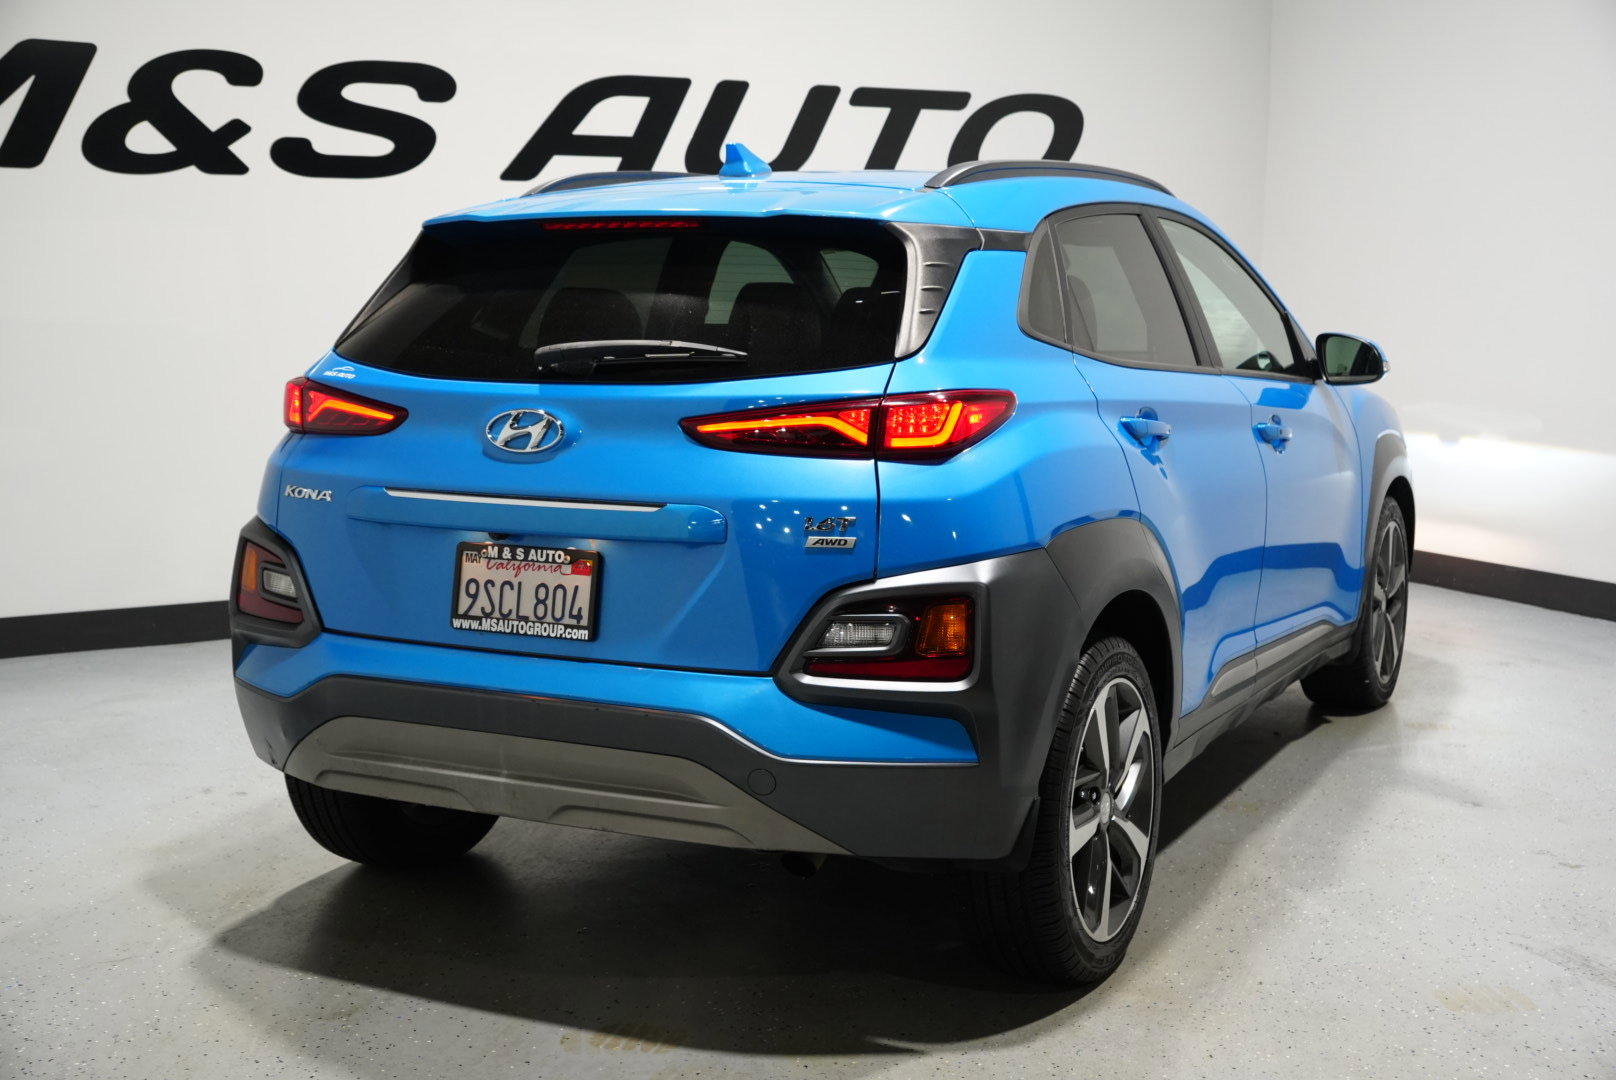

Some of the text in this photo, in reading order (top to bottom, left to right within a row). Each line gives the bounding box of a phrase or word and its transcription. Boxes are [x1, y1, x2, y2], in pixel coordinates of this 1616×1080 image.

[500, 74, 1084, 181] AUTO
[284, 484, 332, 502] KONA
[812, 538, 848, 547] AWD
[465, 552, 482, 564] MAY
[487, 545, 565, 563] M & S AUTO
[462, 577, 584, 625] 9SCL804
[452, 617, 589, 640] www.MSAUTOGROUP.com
